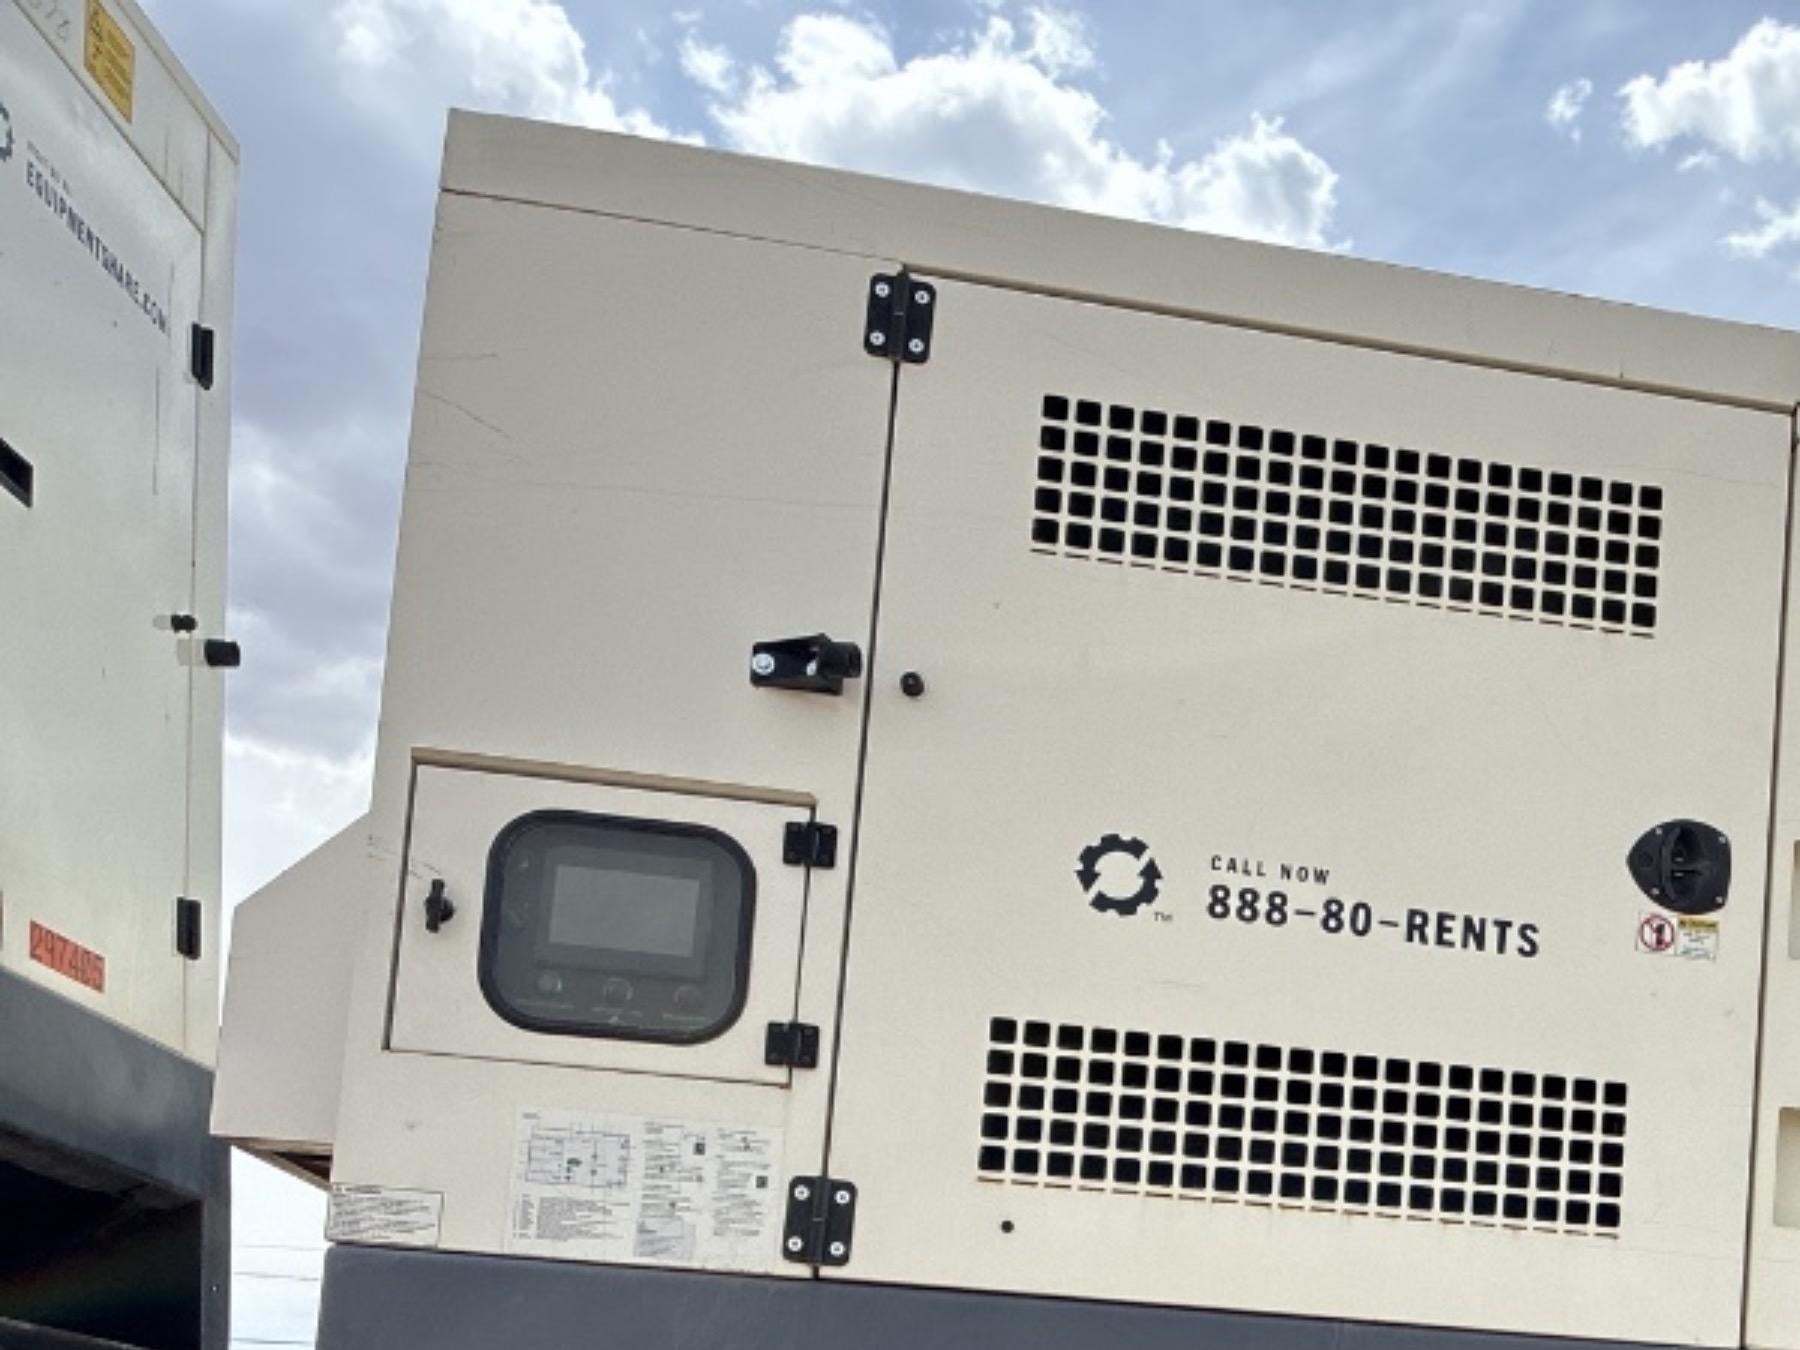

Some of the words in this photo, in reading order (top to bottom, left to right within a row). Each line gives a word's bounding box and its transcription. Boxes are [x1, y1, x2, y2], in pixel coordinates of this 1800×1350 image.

[1211, 854, 1267, 877] CALL
[1280, 863, 1331, 886] NOW
[1206, 884, 1540, 958] 888-80-RENTS
